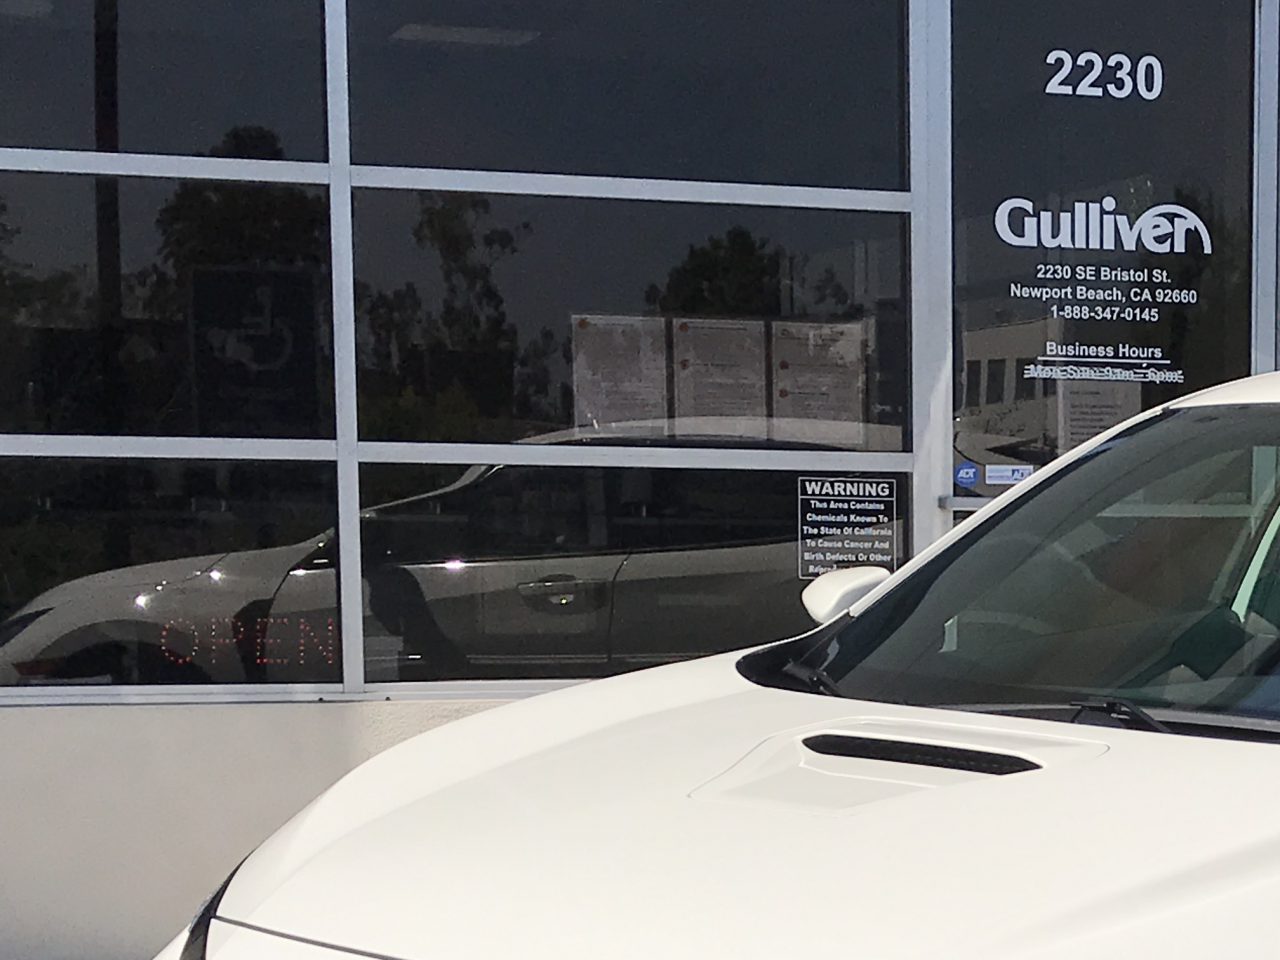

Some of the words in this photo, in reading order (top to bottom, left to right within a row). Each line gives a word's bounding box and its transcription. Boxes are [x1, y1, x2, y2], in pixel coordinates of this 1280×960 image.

[1045, 49, 1163, 100] 2230
[994, 196, 1212, 255] Gulliver
[1036, 265, 1072, 279] 2230
[1075, 266, 1096, 280] SE
[1100, 267, 1148, 282] Bristol
[1152, 269, 1172, 283] St.
[1010, 283, 1073, 302] Newport
[1076, 286, 1126, 303] Beach,
[1130, 288, 1152, 302] CA
[1155, 289, 1197, 303] 92660
[1050, 305, 1159, 321] 1-888-347-0145
[1046, 341, 1115, 357] Business
[1118, 344, 1163, 358] Hours
[805, 481, 890, 496] WARNING
[810, 500, 828, 509] This
[829, 501, 848, 509] Area
[850, 501, 885, 510] Contains
[806, 513, 848, 522] Chemicals
[849, 514, 877, 523] Known
[878, 515, 889, 523] To
[803, 526, 818, 534] The
[819, 526, 841, 535] State
[843, 527, 853, 535] Of
[854, 527, 892, 536] California
[806, 540, 816, 548] To
[817, 540, 842, 549] Cause
[844, 540, 873, 549] Cancer
[873, 541, 890, 549] And
[804, 552, 825, 561] Birth
[825, 552, 856, 561] Defects
[857, 553, 868, 561] Or
[869, 553, 892, 562] Other
[161, 617, 336, 664] OPEN
